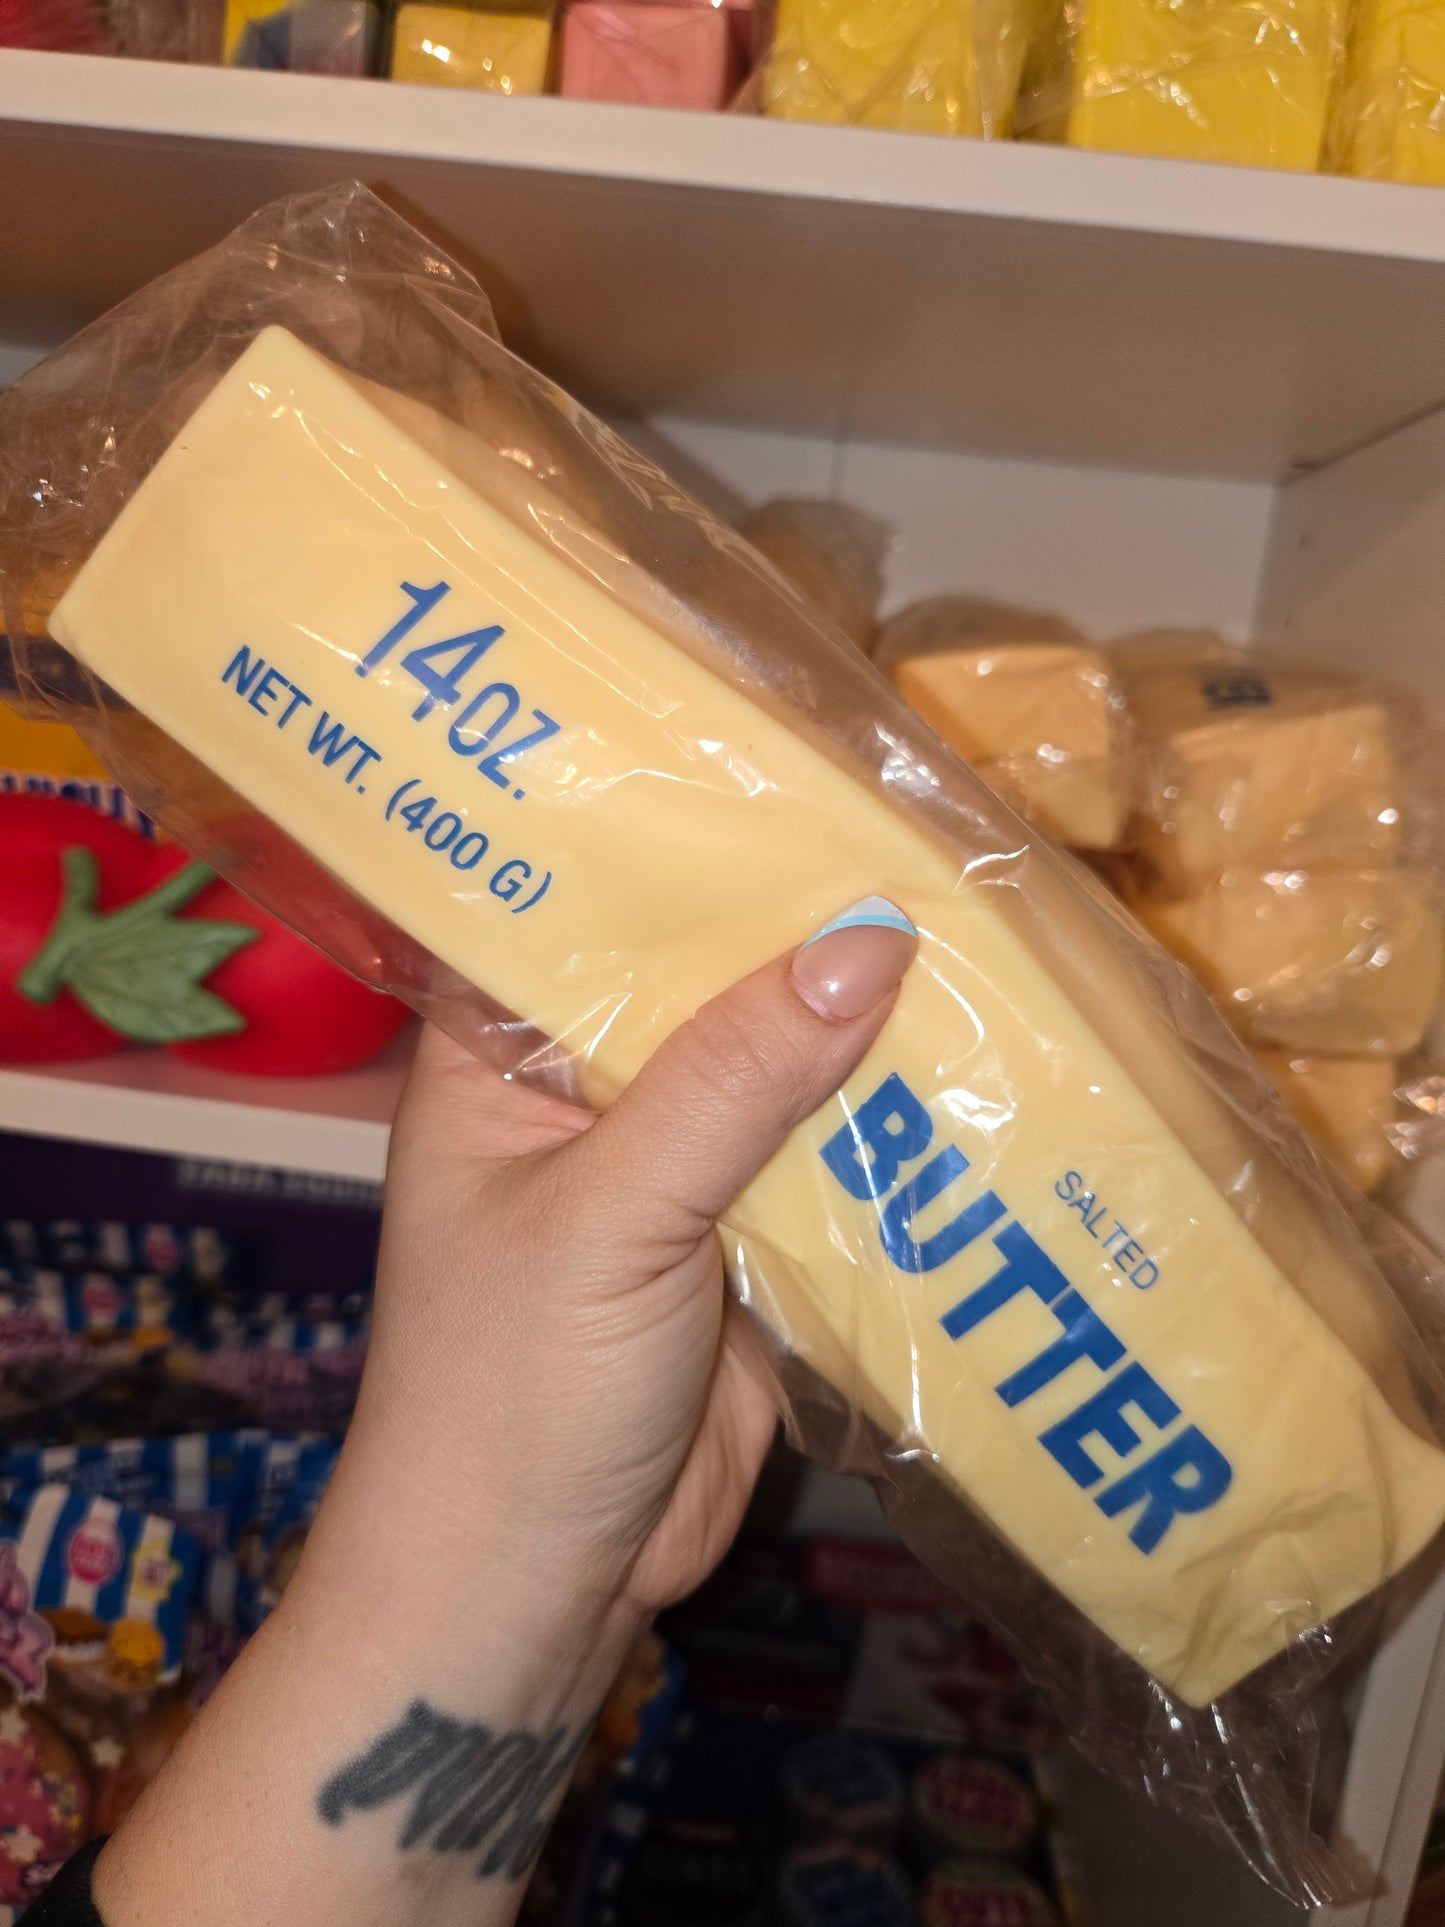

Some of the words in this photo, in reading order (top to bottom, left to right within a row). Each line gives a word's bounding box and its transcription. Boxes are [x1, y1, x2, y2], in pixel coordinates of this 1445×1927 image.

[221, 644, 313, 730] NET
[307, 710, 382, 796] WT.
[385, 778, 490, 871] (400
[488, 858, 553, 915] G)
[818, 1071, 1233, 1557] BUTTER
[1053, 1169, 1160, 1291] SALTED
